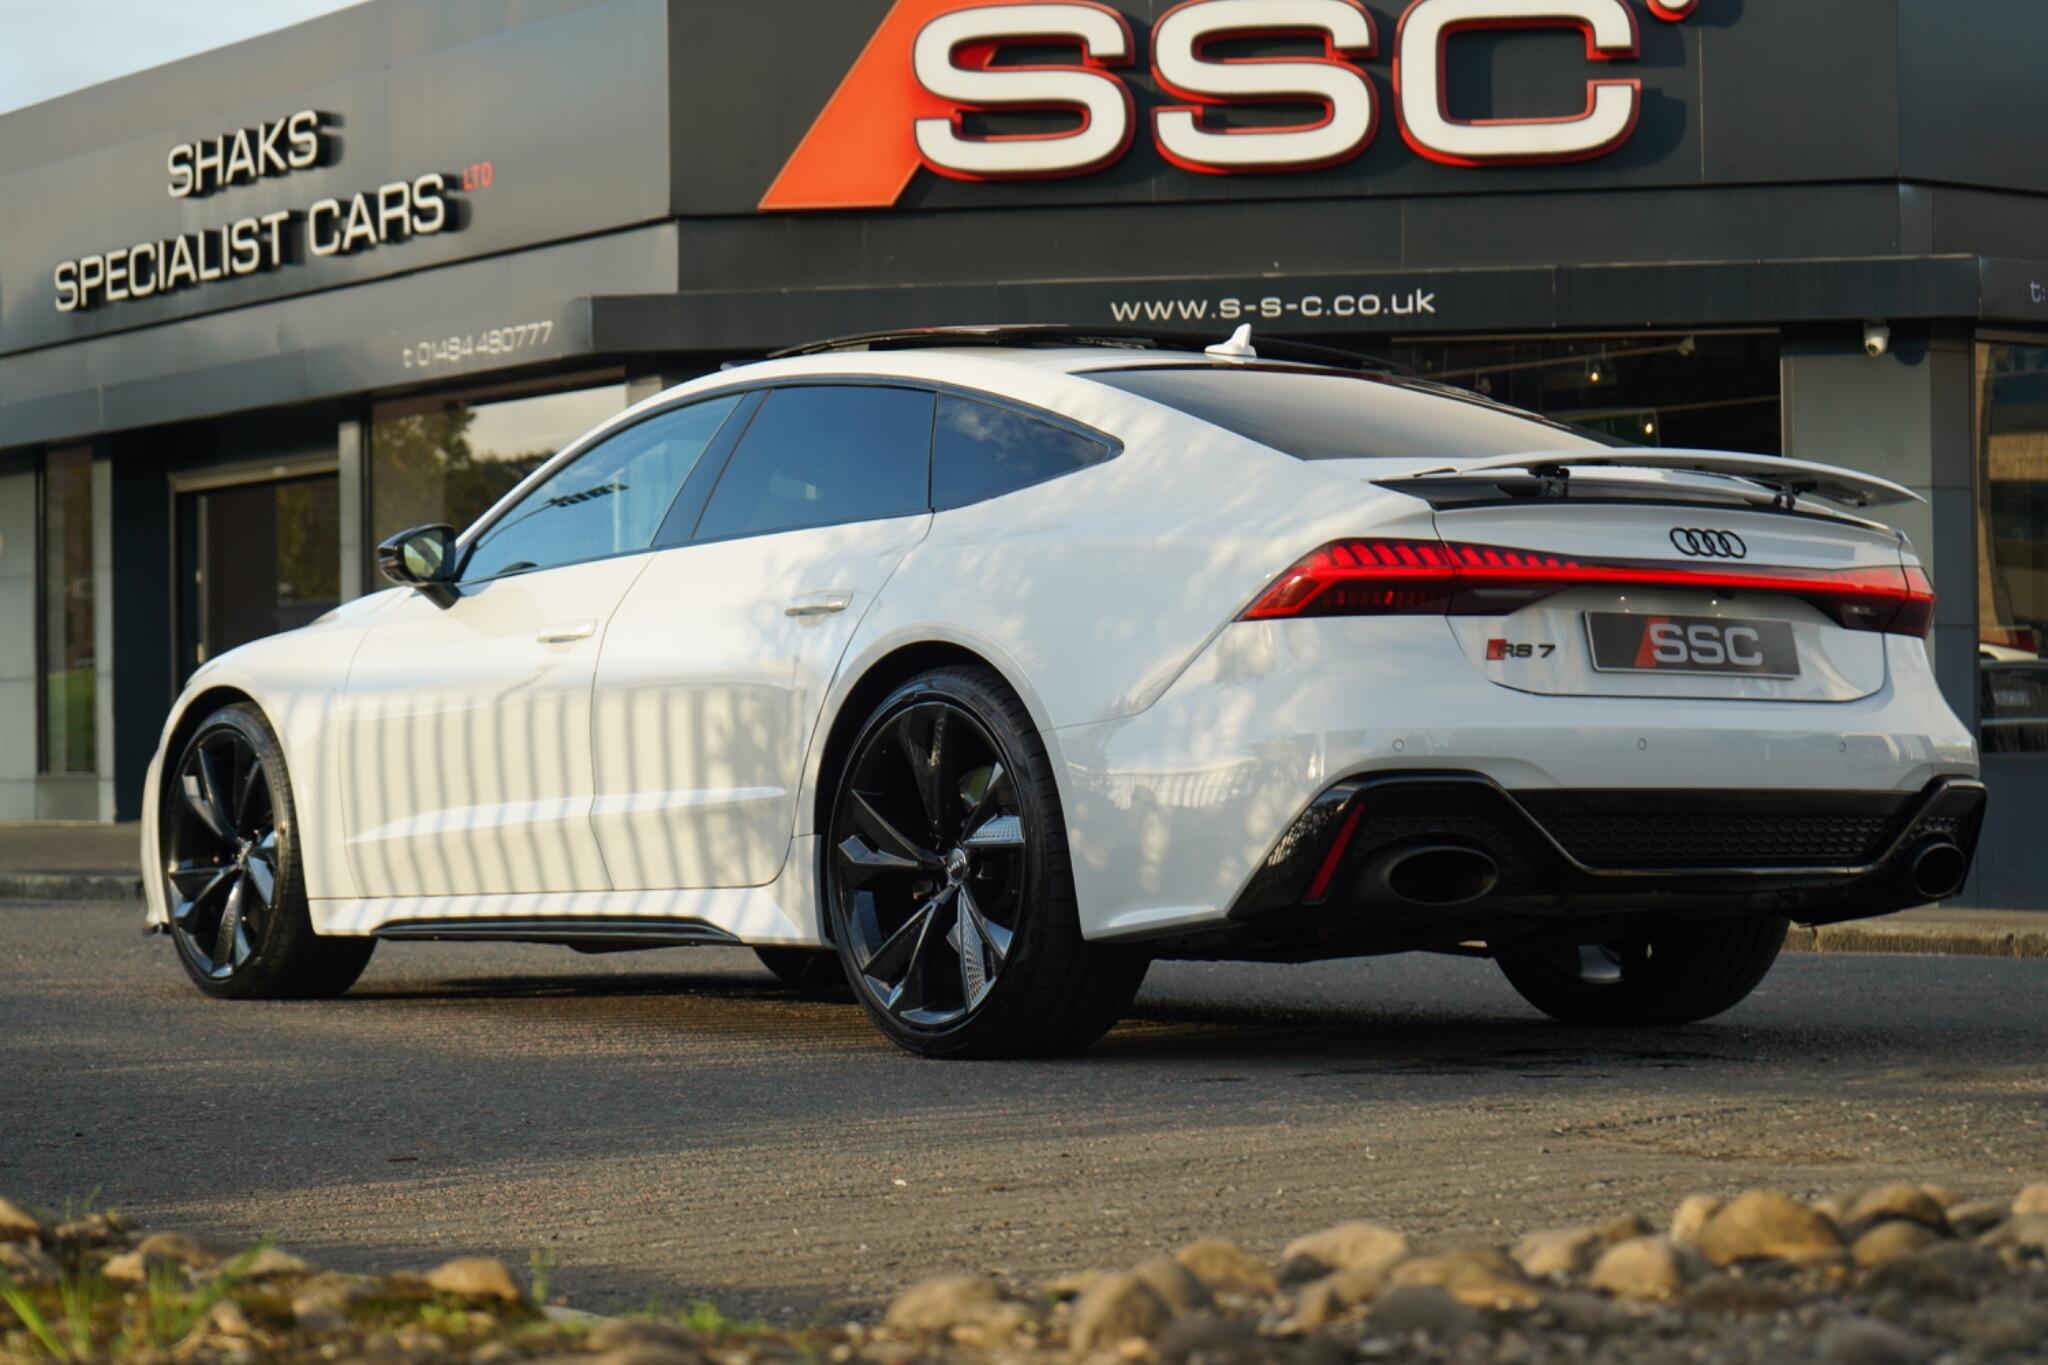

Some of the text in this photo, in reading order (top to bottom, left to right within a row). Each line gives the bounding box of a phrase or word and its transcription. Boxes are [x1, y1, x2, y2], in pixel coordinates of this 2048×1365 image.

[912, 0, 1641, 181] SSC
[167, 109, 319, 199] SHAKS
[54, 210, 290, 312] SPECIALIST
[308, 173, 445, 257] CARS
[1110, 288, 1436, 322] www.s-s-c.co.uk
[475, 319, 554, 355] 480777
[1497, 643, 1556, 658] RS 7
[1650, 623, 1763, 667] SSC
